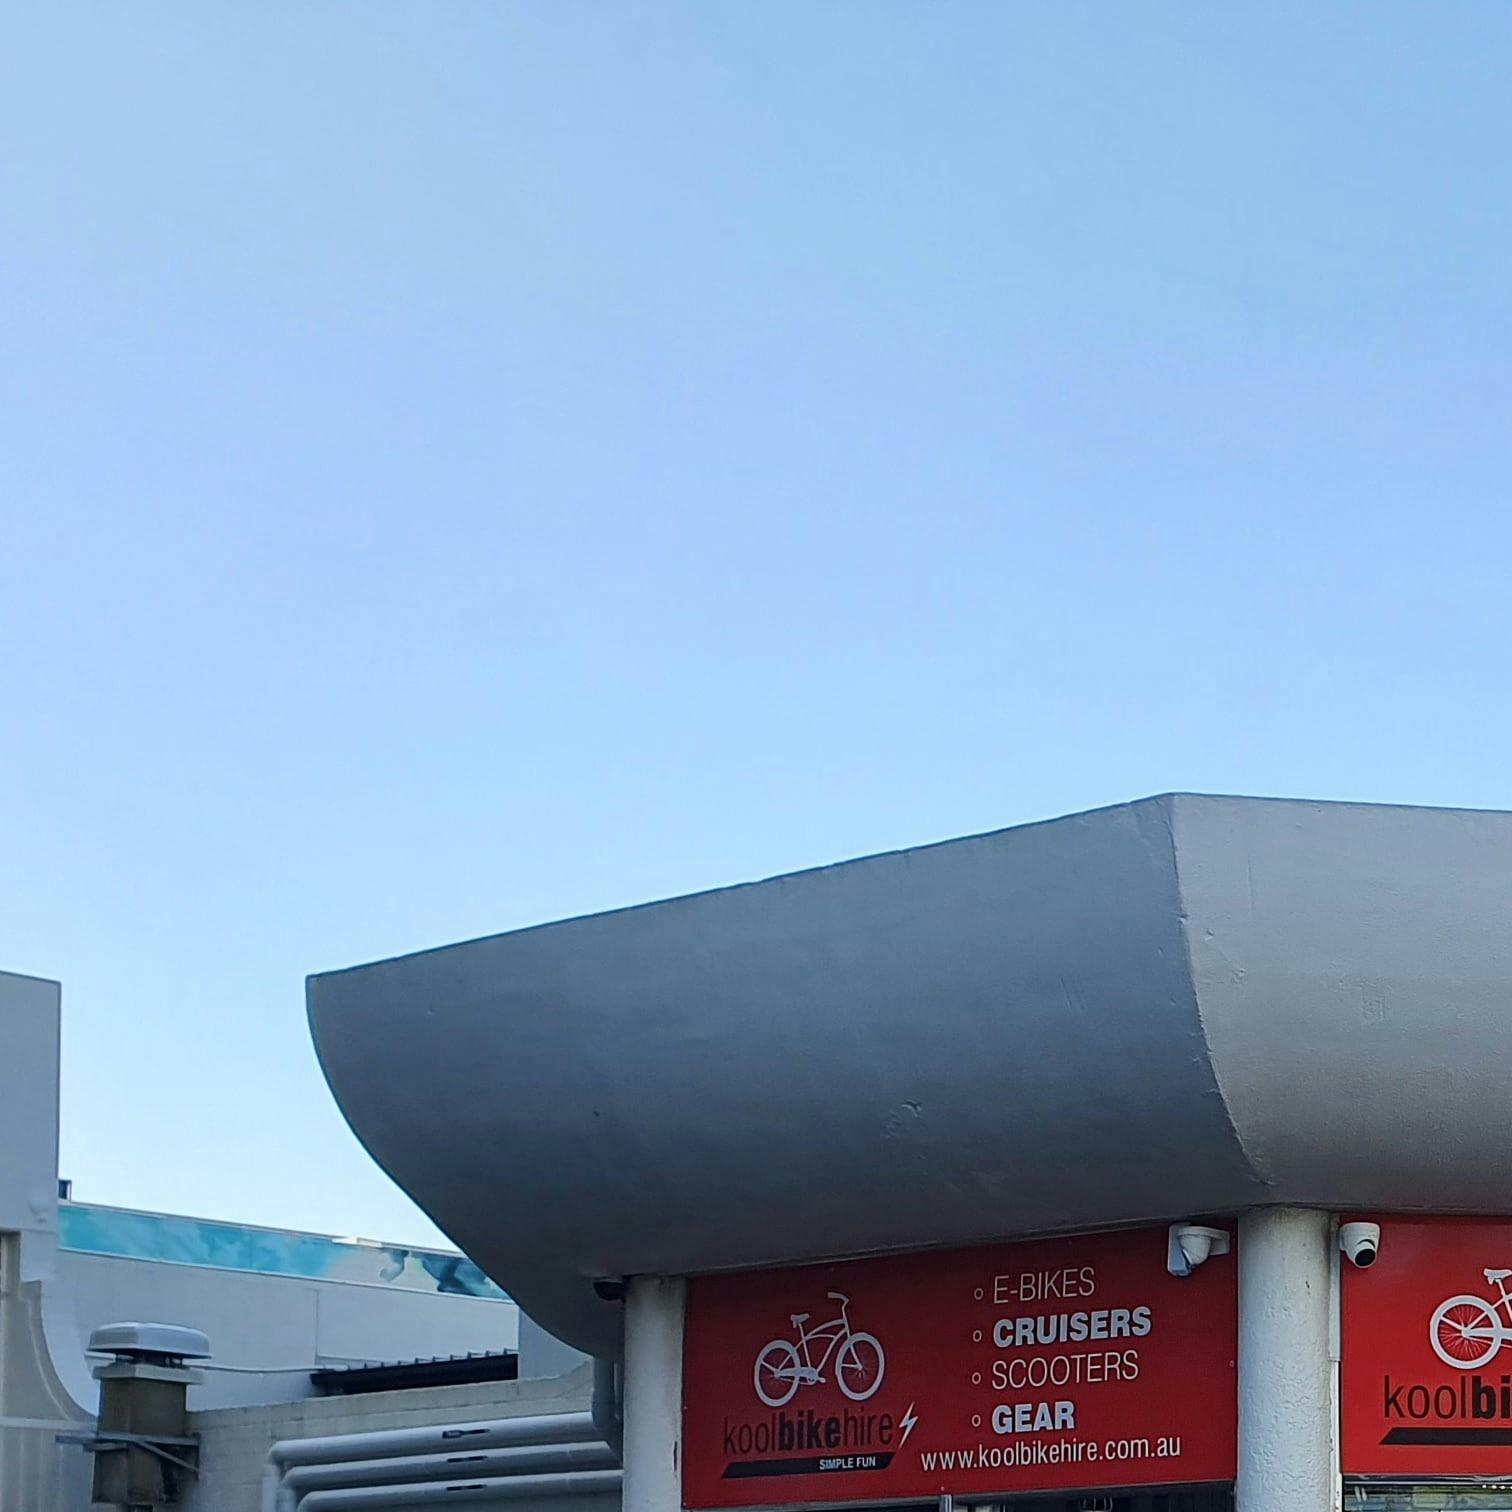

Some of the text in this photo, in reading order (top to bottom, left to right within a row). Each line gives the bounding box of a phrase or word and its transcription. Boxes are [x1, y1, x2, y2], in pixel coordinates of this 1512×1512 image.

[993, 1266, 1096, 1304] E-BIKES
[992, 1306, 1152, 1348] CRUISERS
[991, 1350, 1140, 1391] SCOOTERS
[723, 1405, 894, 1456] koolbikehire
[991, 1401, 1076, 1436] GEAR
[819, 1455, 876, 1470] SIMPLE FUN
[920, 1433, 1182, 1473] www.koolbikehire.com.au
